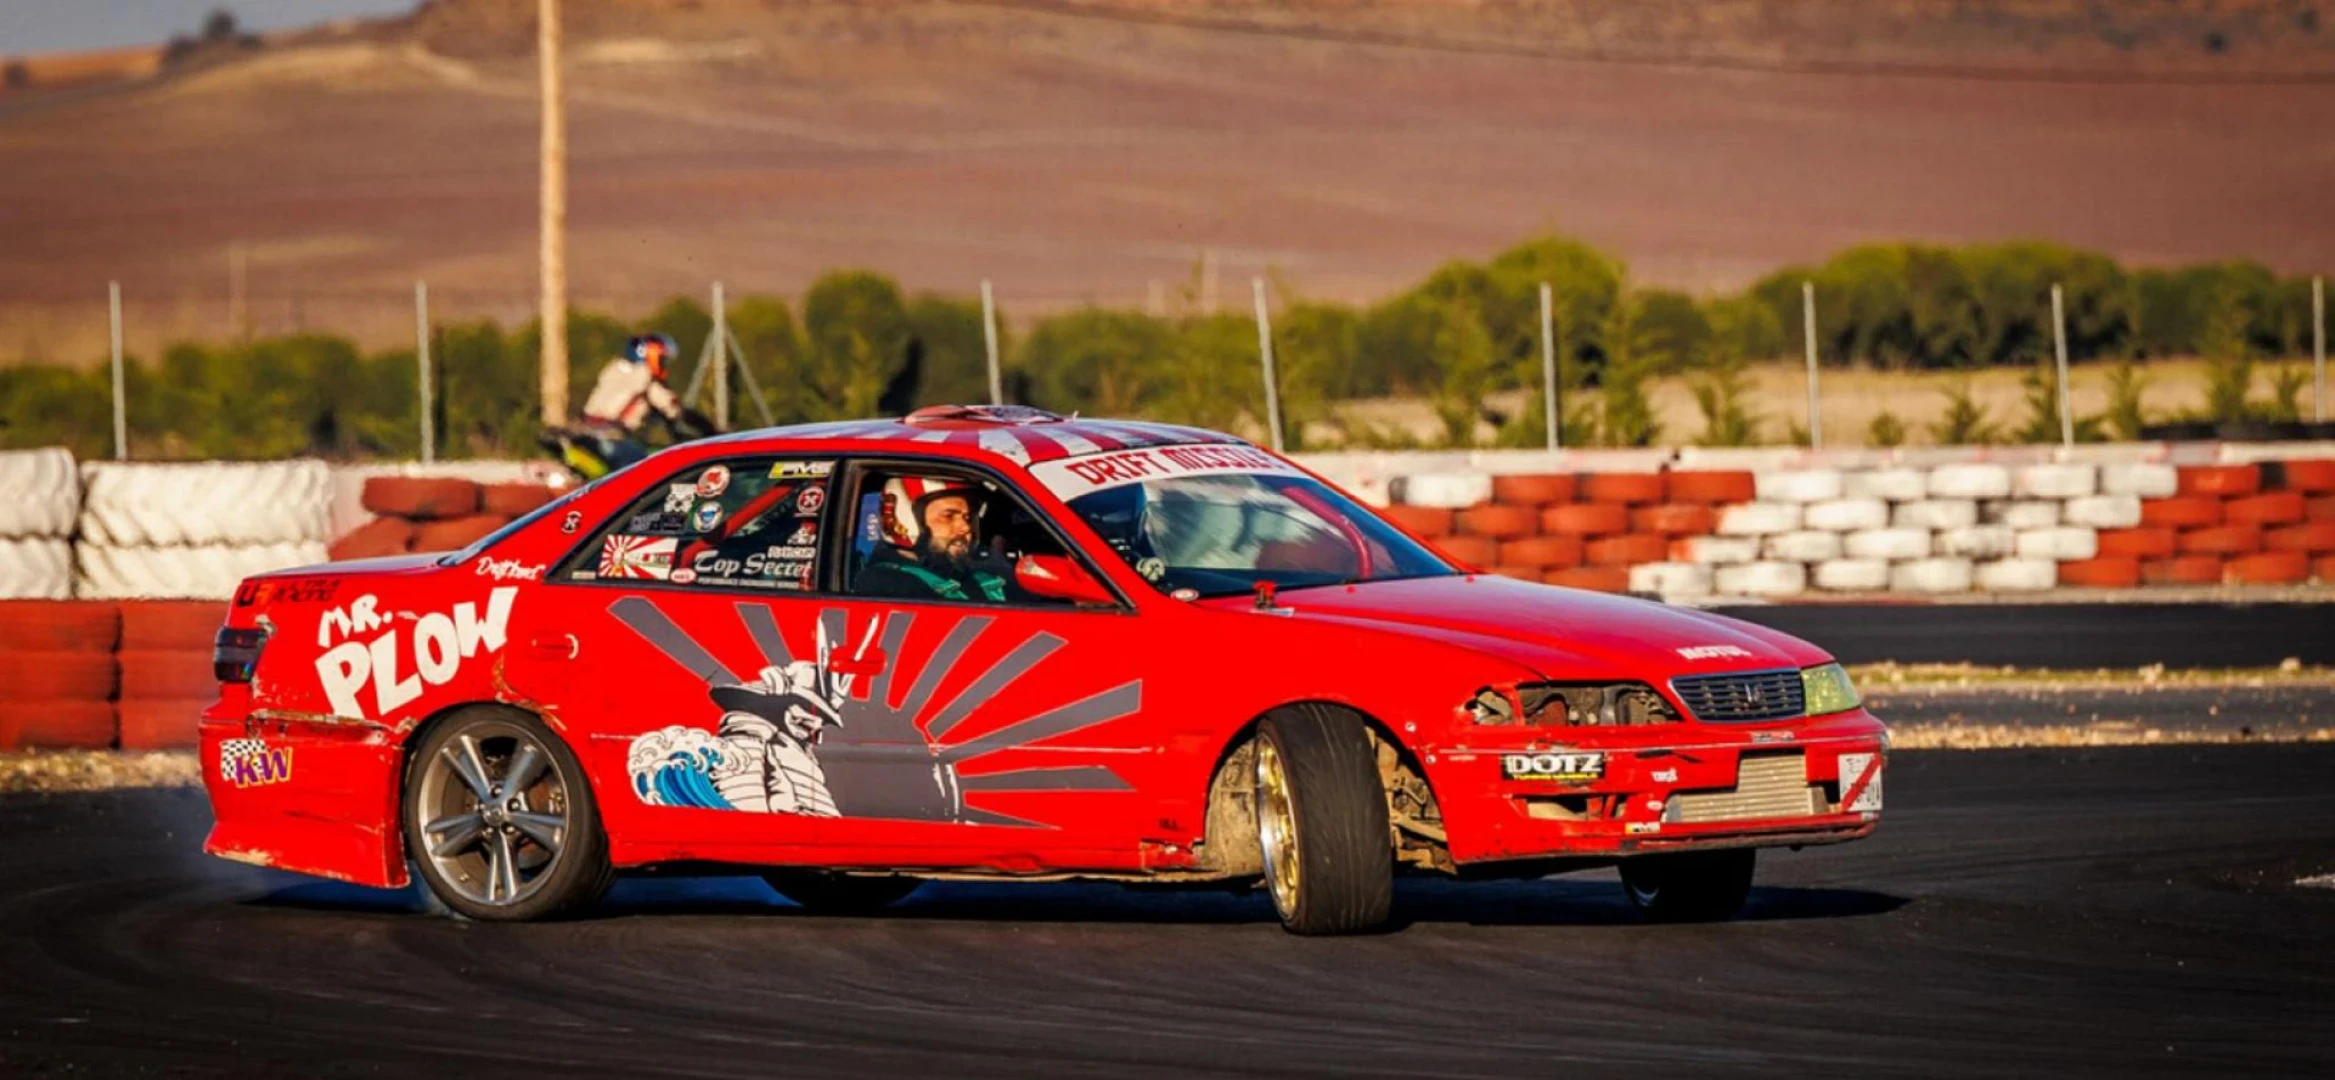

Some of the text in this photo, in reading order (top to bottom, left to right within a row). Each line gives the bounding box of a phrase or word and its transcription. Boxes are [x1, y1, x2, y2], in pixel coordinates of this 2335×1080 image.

[1065, 452, 1171, 485] DRIFT
[694, 550, 740, 577] Top
[743, 553, 813, 578] Secret
[318, 594, 393, 648] MR.
[315, 586, 519, 719] PLOW
[234, 747, 294, 788] KW
[1505, 754, 1603, 773] DOTZ
